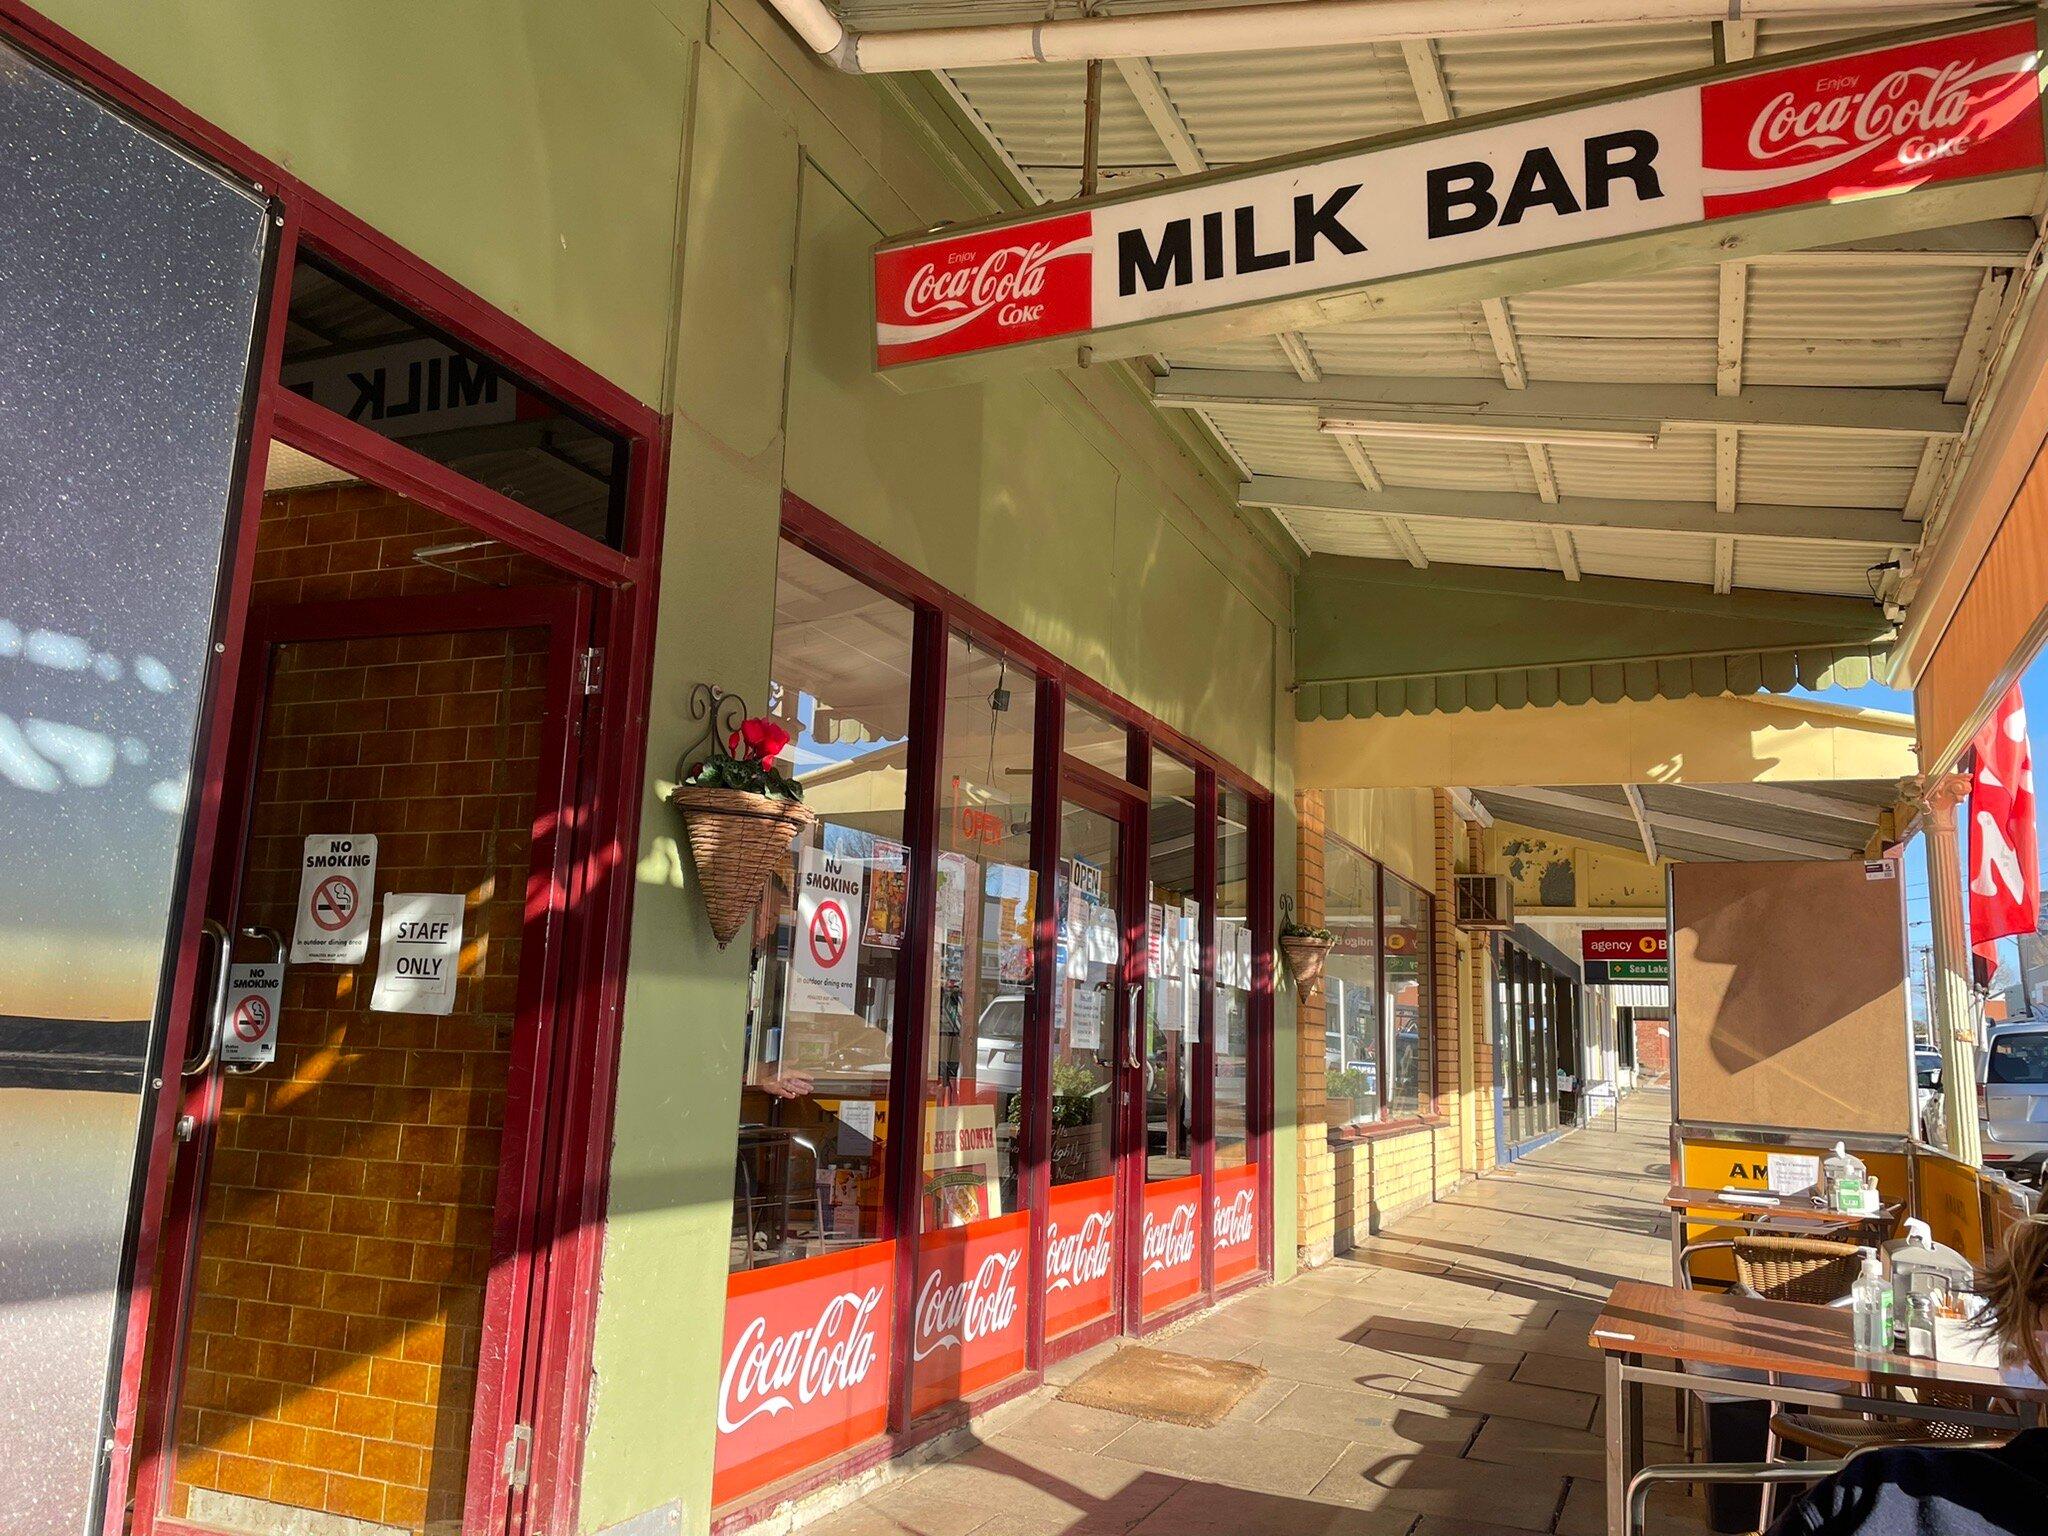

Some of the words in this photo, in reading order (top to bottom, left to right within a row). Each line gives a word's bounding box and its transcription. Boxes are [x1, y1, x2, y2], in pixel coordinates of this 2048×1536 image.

[1815, 74, 1861, 93] Enjoy
[1748, 58, 1977, 160] Coca-Cola
[1896, 134, 1971, 166] Coke
[1117, 183, 1368, 297] MILK
[1427, 129, 1665, 240] BAR
[948, 251, 977, 264] Enjoy
[904, 240, 1051, 317] Coca-Cola
[997, 302, 1045, 326] Coke
[330, 841, 352, 853] NO
[306, 854, 371, 868] SMOKING
[825, 858, 842, 875] NO
[806, 872, 860, 896] SMOKING
[1074, 862, 1100, 897] OPEN
[397, 922, 449, 940] STAFF
[1590, 940, 1632, 952] agency
[249, 968, 265, 978] NO
[396, 957, 442, 976] ONLY
[1629, 964, 1646, 973] Sea
[1648, 965, 1668, 973] Lake
[233, 979, 279, 989] SMOKING
[913, 1247, 1022, 1362] Coca-Cola
[717, 1284, 884, 1434] Coca-Cola
